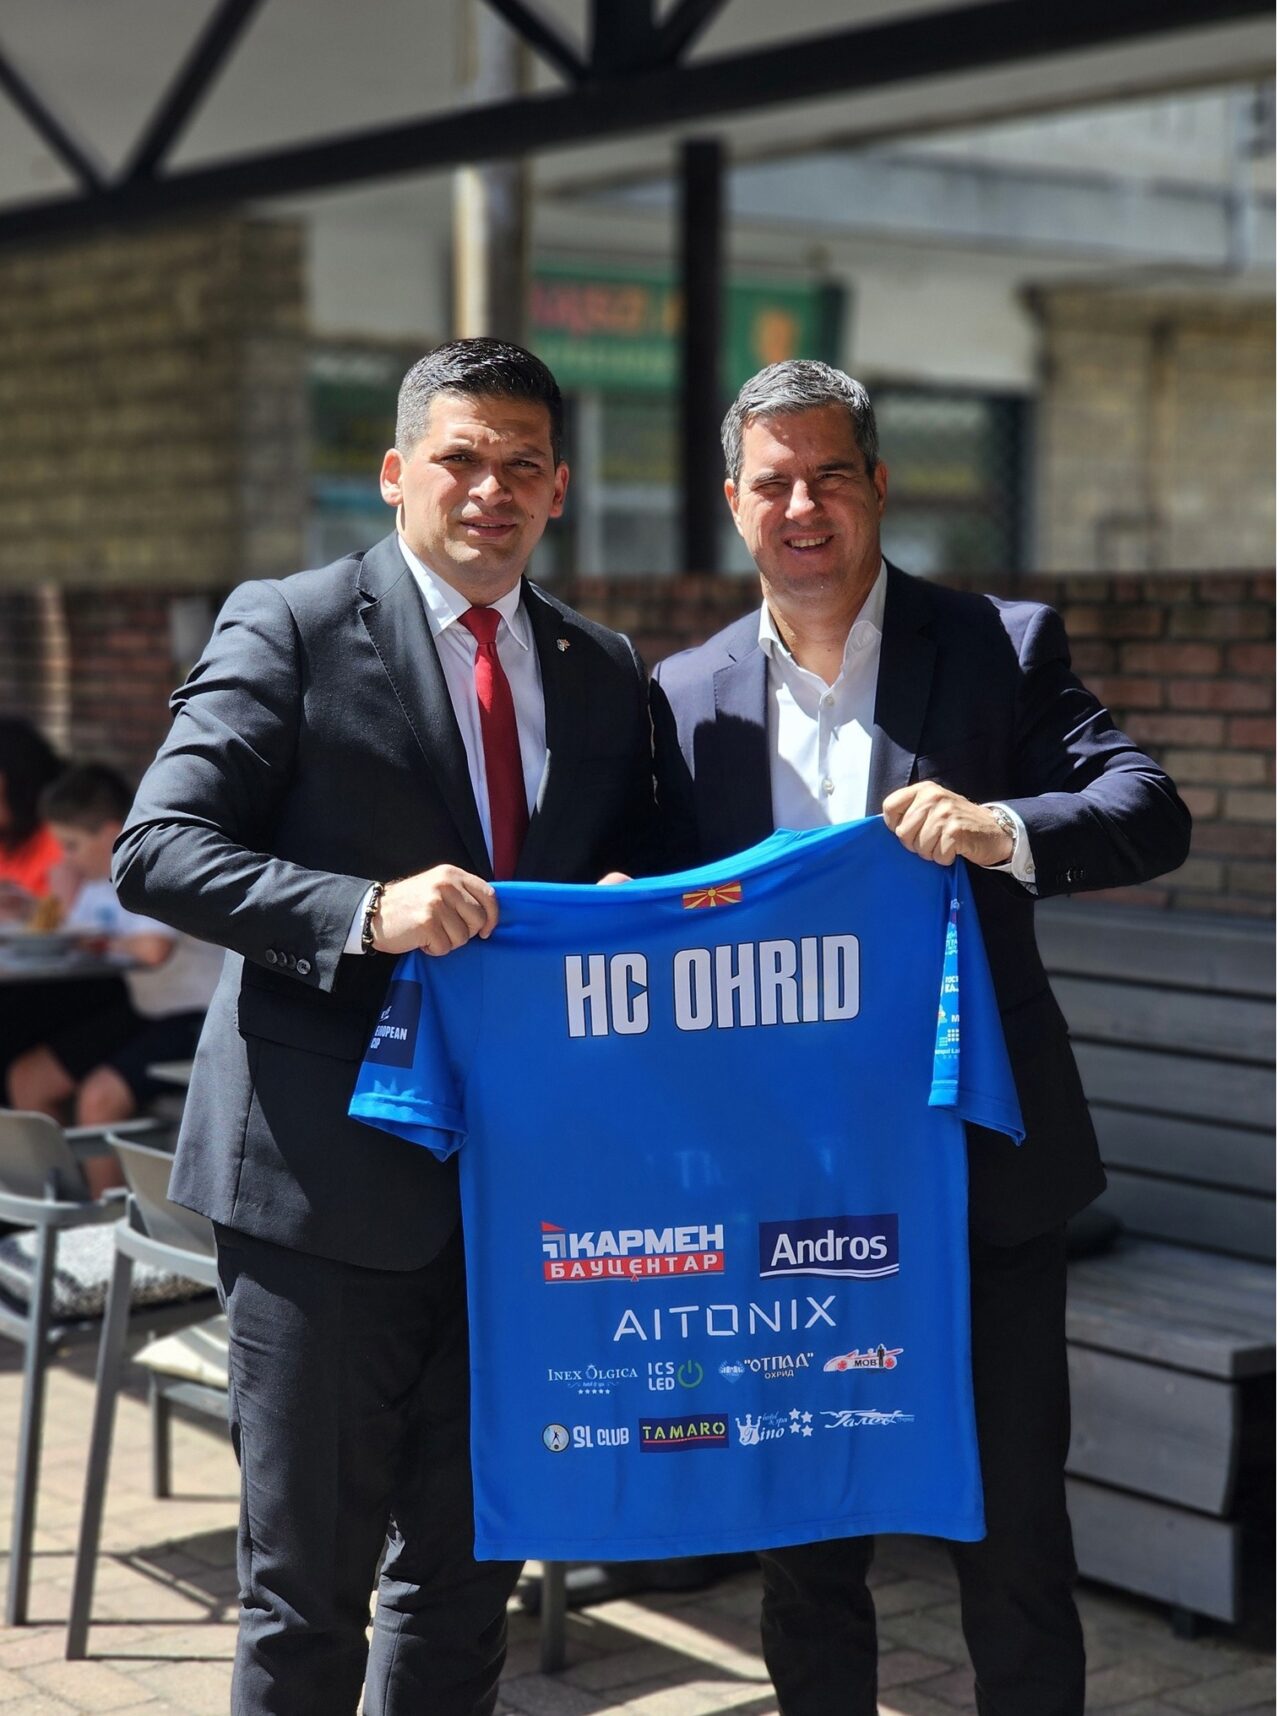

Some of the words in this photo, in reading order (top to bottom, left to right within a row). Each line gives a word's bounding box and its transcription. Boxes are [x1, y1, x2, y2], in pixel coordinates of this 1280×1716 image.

[565, 954, 649, 1038] HC
[673, 934, 860, 1031] OHRID
[569, 1224, 724, 1259] КАРМЕН
[770, 1229, 888, 1267] Andros
[551, 1253, 719, 1280] БАУЦЕНТАР
[613, 1295, 837, 1342] AITONIX
[647, 1361, 675, 1376] ICS
[764, 1369, 794, 1380] ОХРИД
[648, 1377, 675, 1391] LED
[573, 1425, 594, 1448] SL
[597, 1427, 630, 1446] CLUB
[642, 1421, 726, 1440] TAMARO
